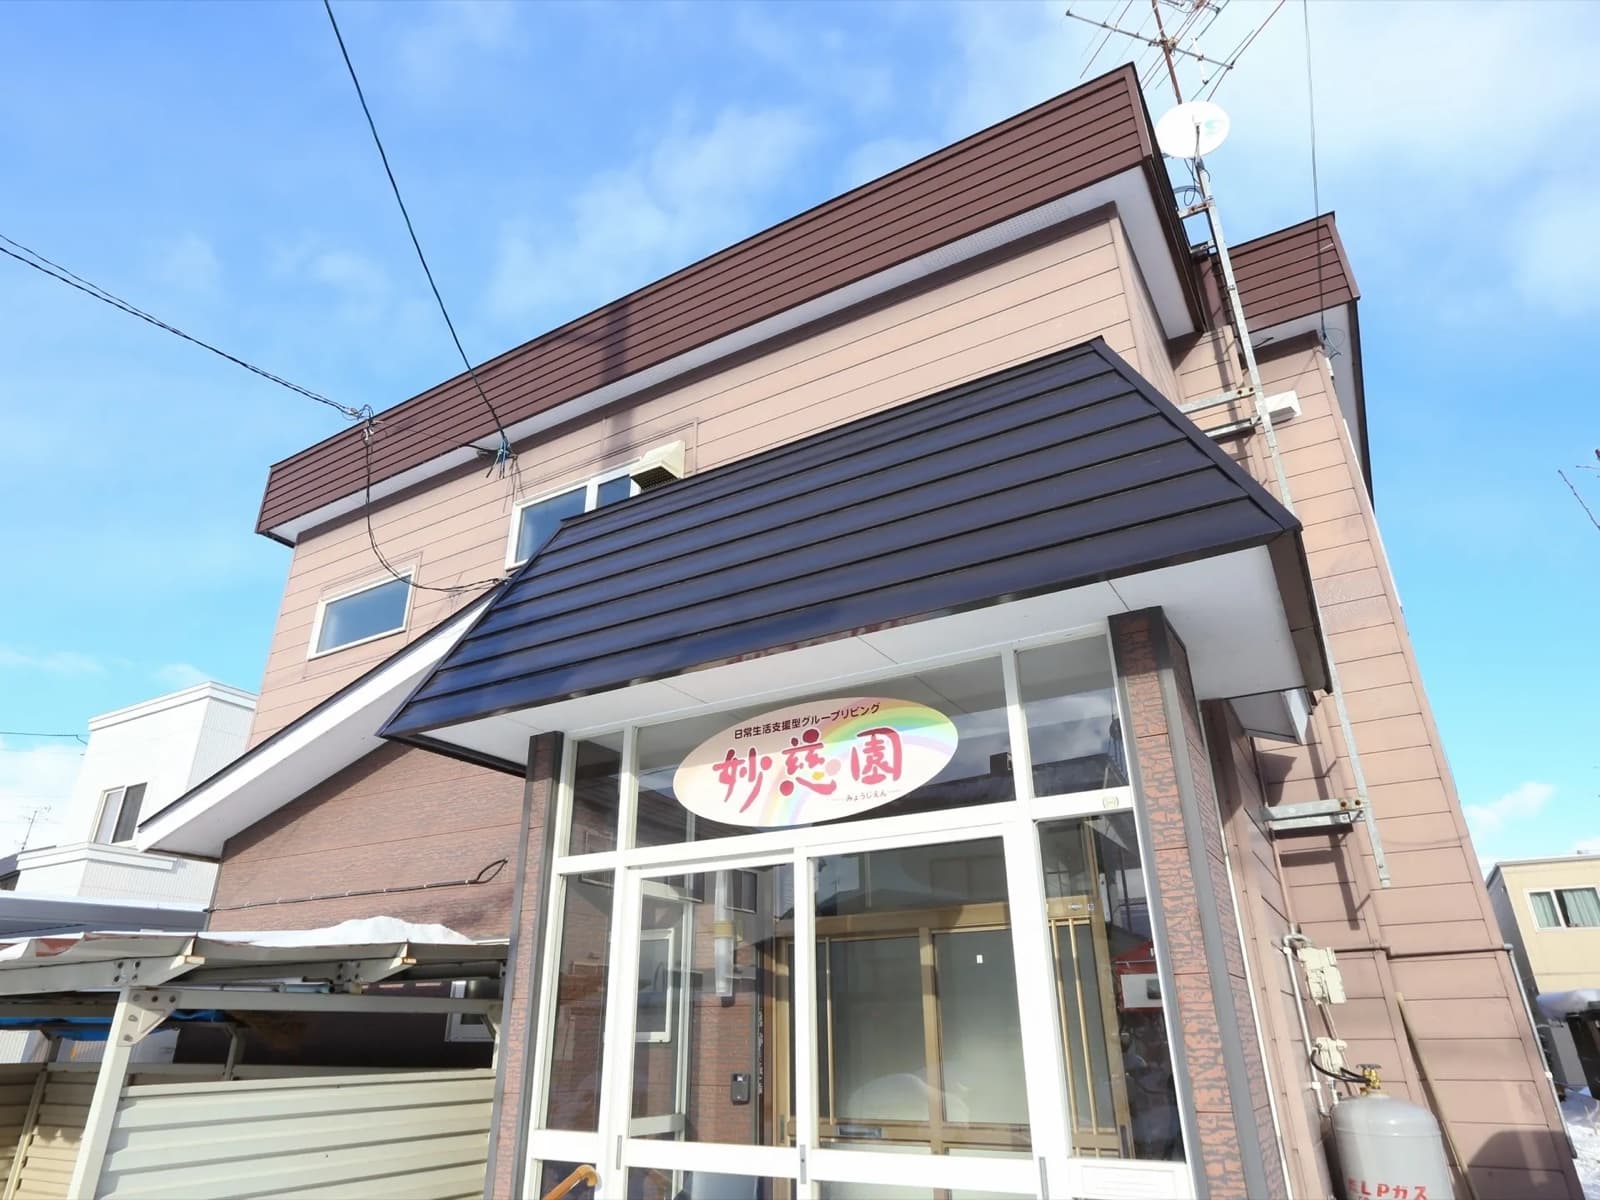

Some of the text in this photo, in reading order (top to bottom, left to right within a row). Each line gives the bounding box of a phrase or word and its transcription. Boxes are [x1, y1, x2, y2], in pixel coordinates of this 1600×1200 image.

[734, 702, 881, 739] 日常生活支援型グループリビング
[712, 728, 903, 813] 妙慈園
